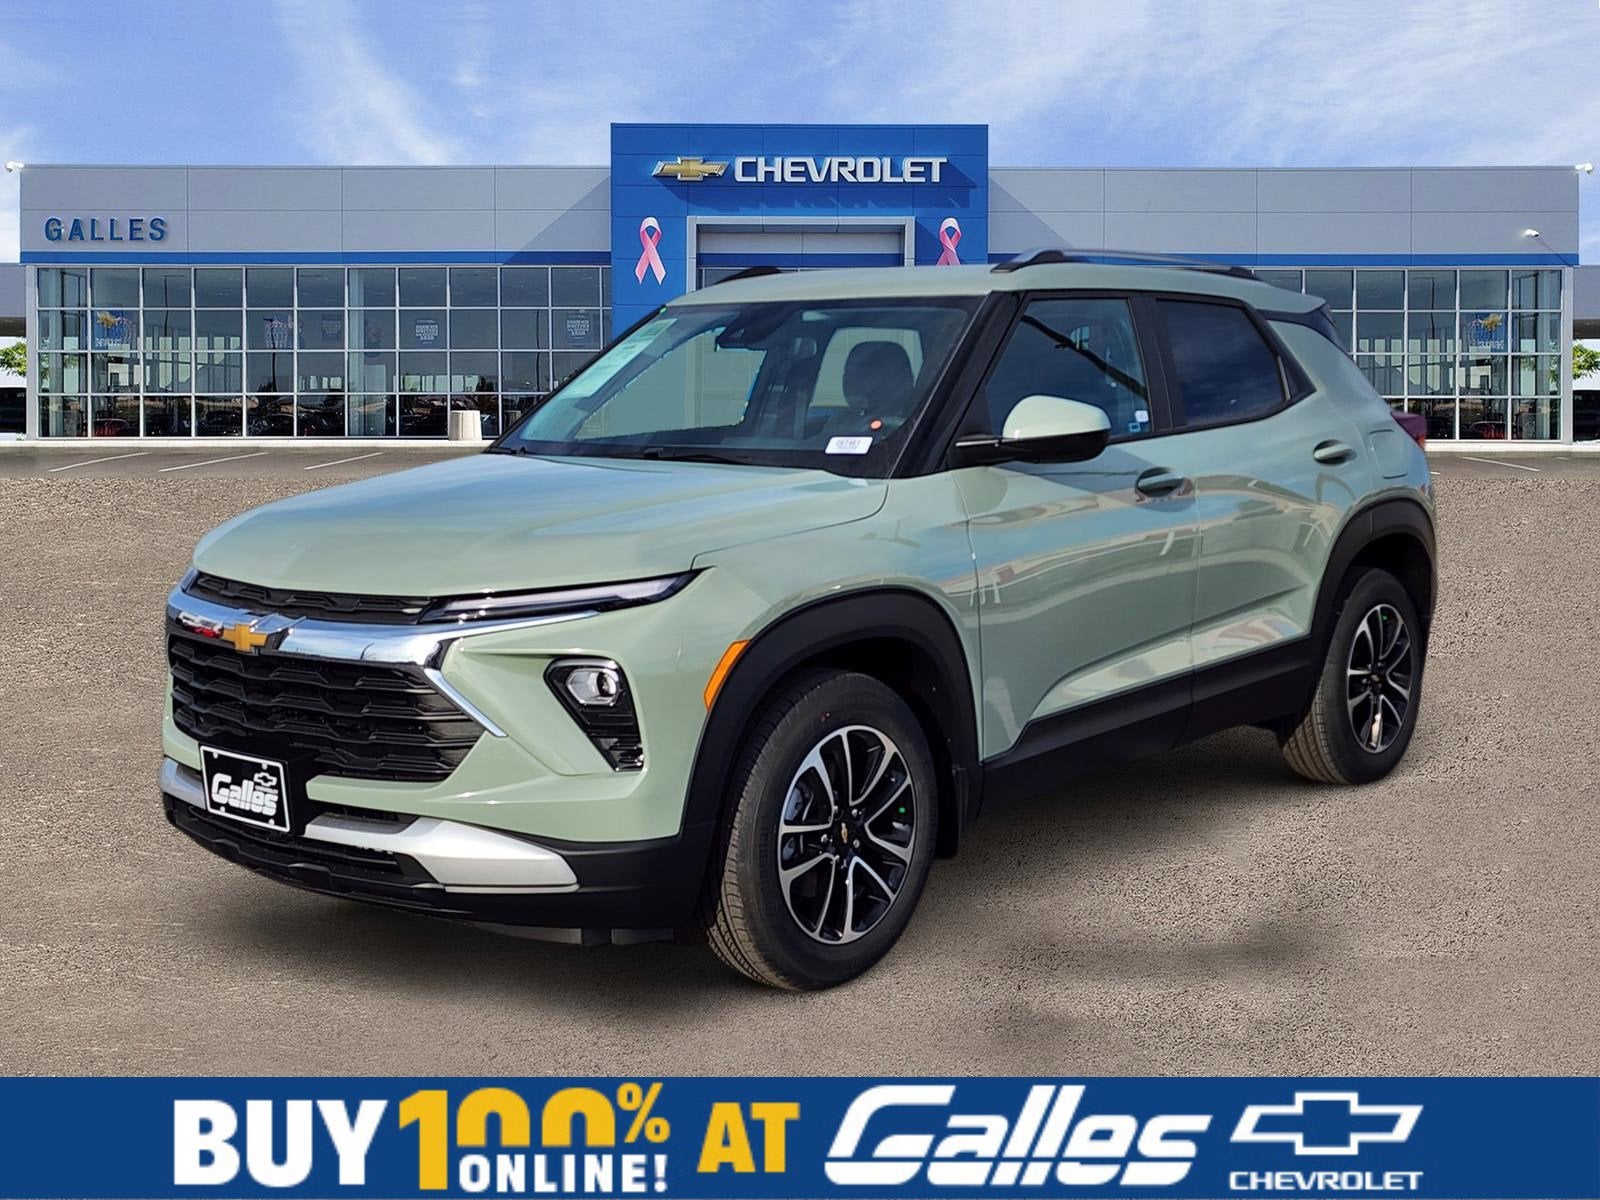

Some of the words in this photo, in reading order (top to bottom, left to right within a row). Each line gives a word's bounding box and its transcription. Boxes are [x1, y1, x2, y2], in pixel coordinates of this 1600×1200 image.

[734, 156, 947, 182] CHEVROLET
[44, 217, 165, 241] GALLES
[211, 772, 279, 816] Galles
